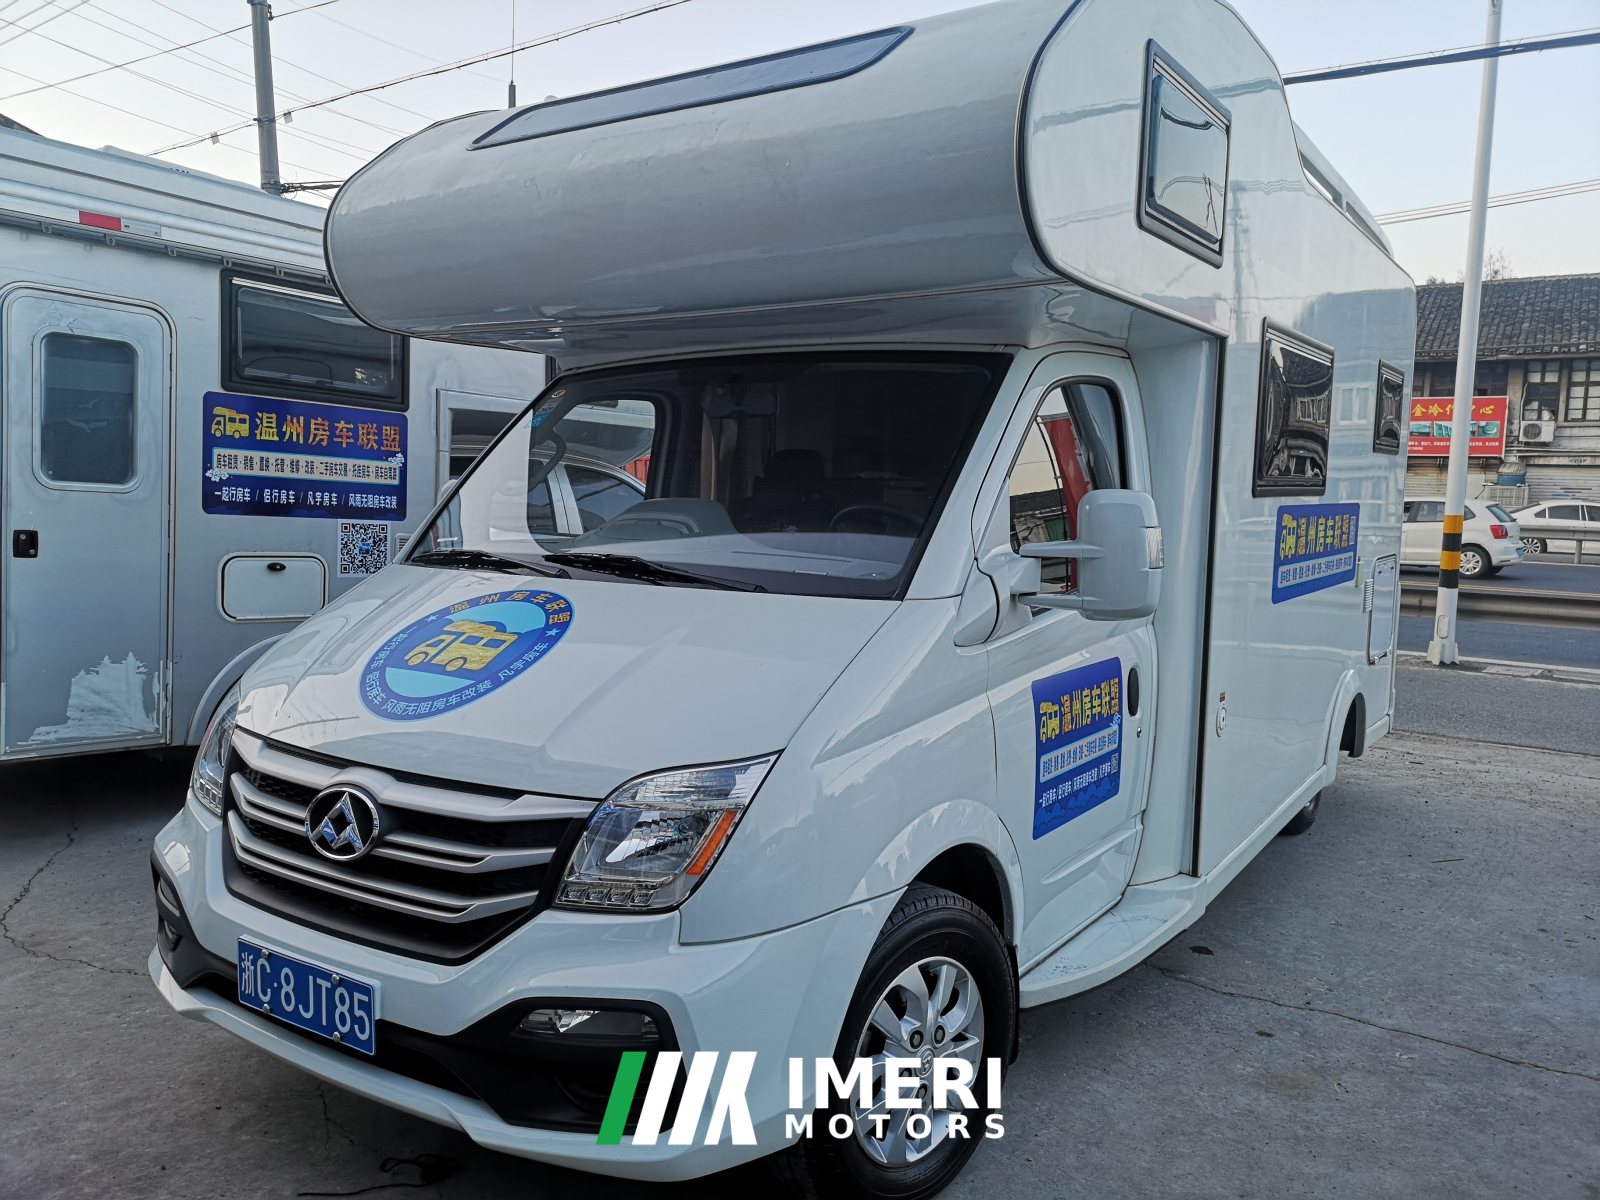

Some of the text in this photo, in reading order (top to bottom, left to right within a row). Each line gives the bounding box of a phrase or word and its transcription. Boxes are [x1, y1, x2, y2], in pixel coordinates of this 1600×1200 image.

[255, 412, 401, 451] 温州房车联盟
[214, 486, 251, 502] 一起行房车
[450, 591, 570, 624] 温州房车联盟
[1061, 677, 1119, 735] 温州房车联盟
